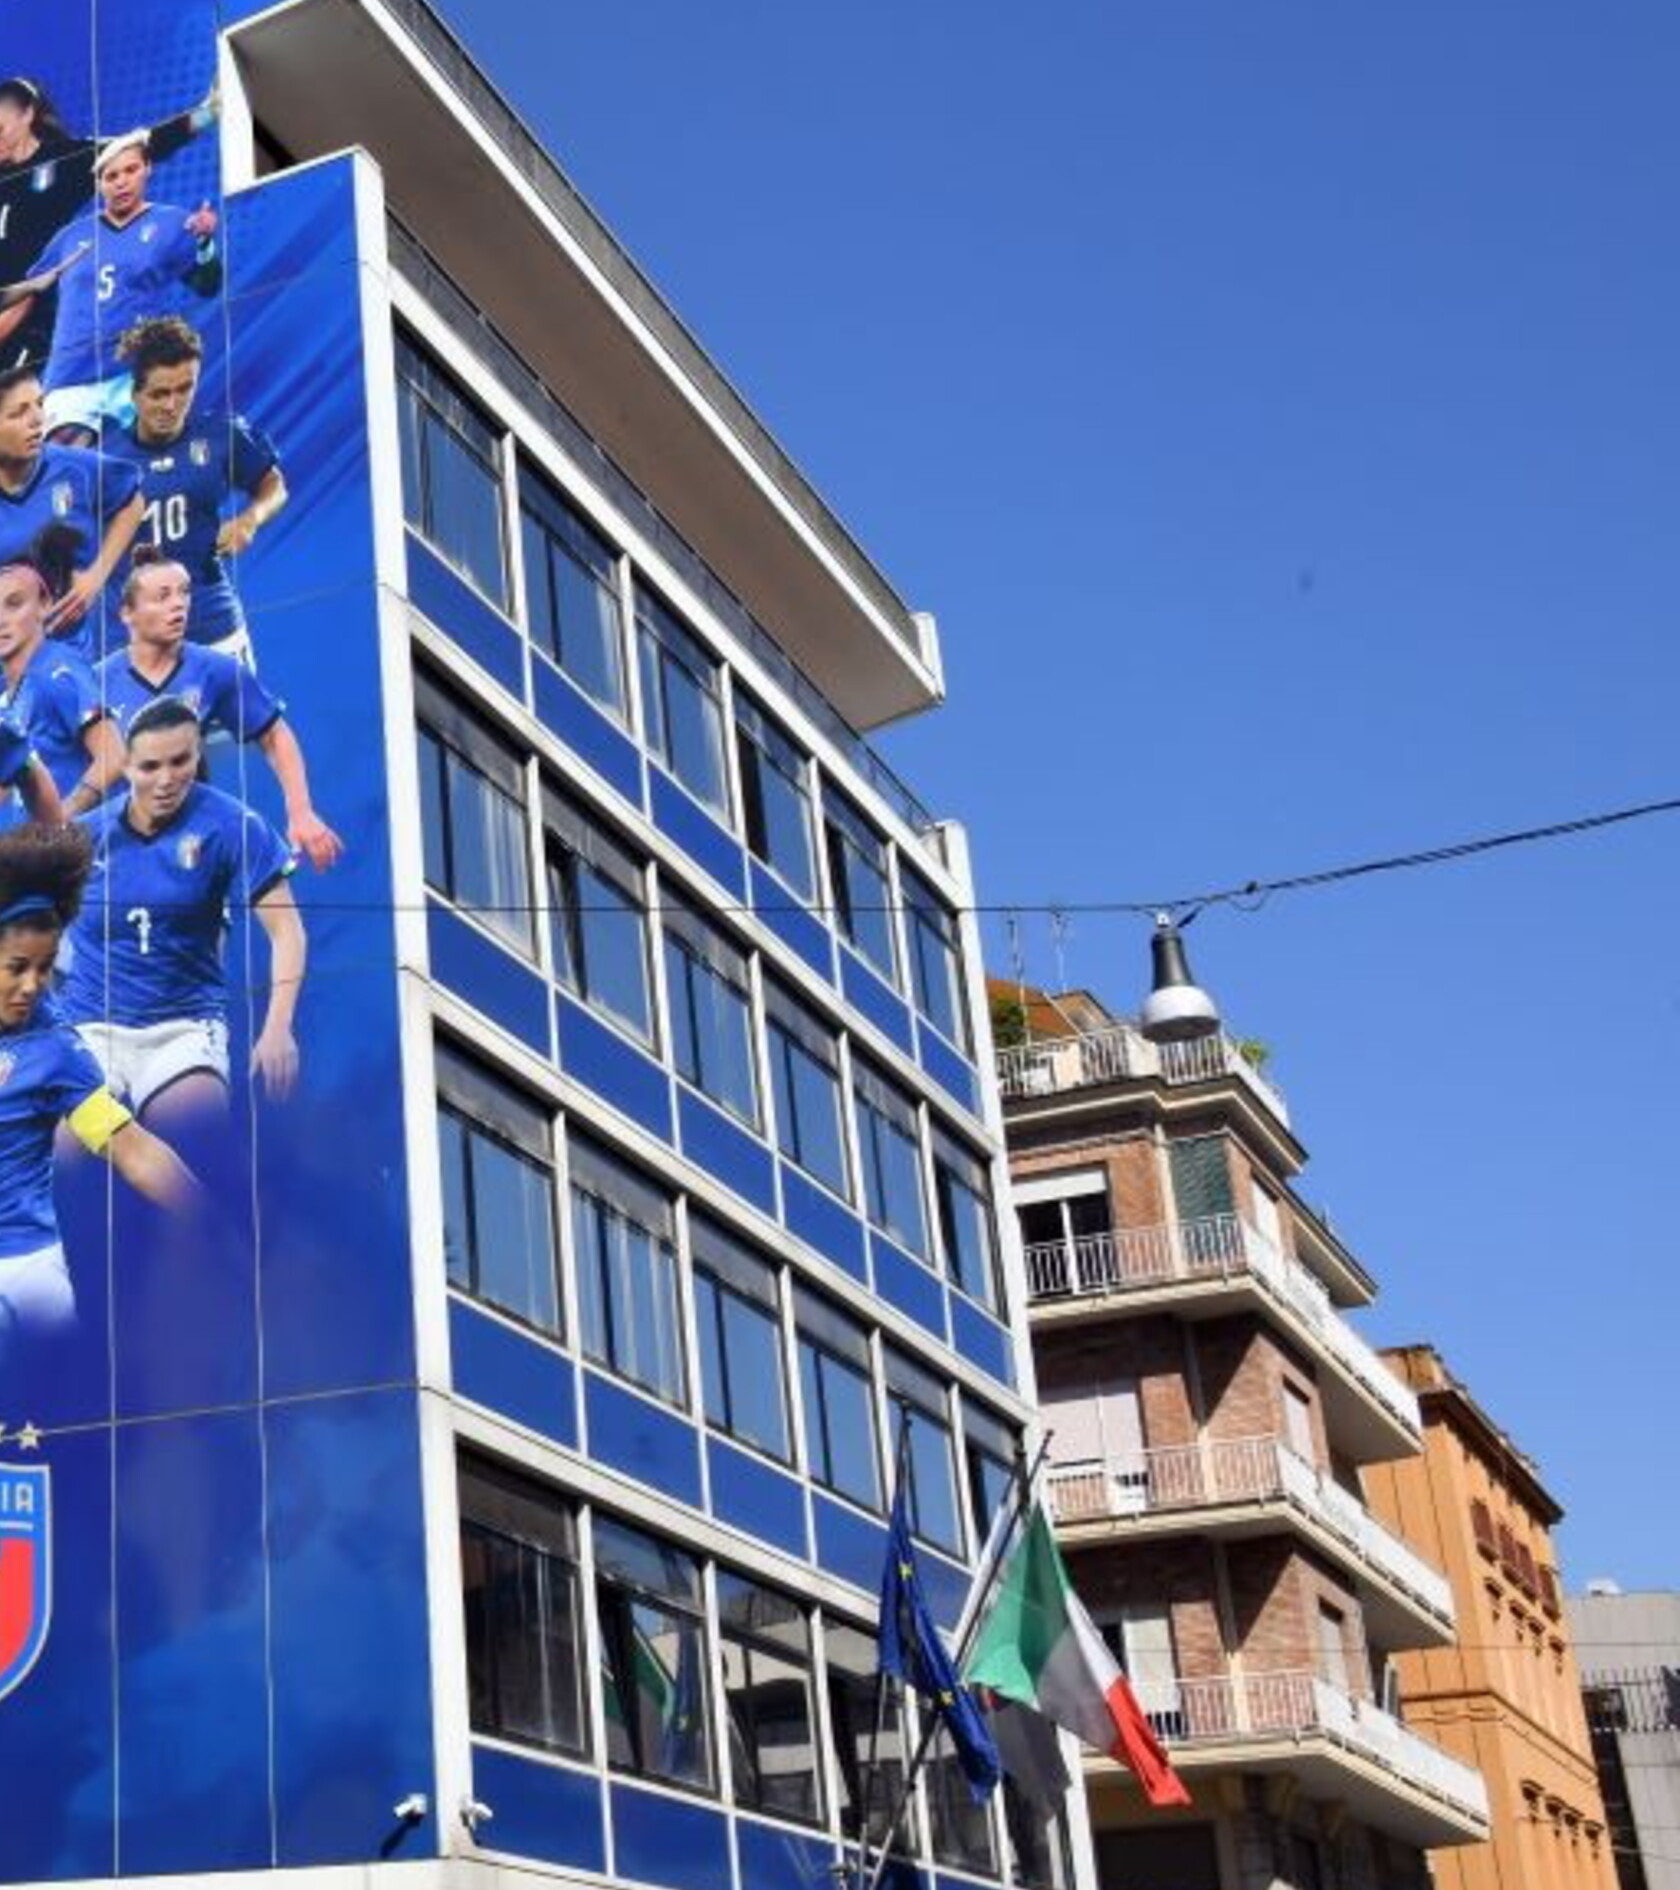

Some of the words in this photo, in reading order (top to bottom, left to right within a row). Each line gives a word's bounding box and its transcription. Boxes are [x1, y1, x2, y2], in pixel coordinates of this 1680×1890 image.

[98, 265, 116, 300] 5
[141, 494, 187, 547] 10
[127, 907, 152, 954] 7
